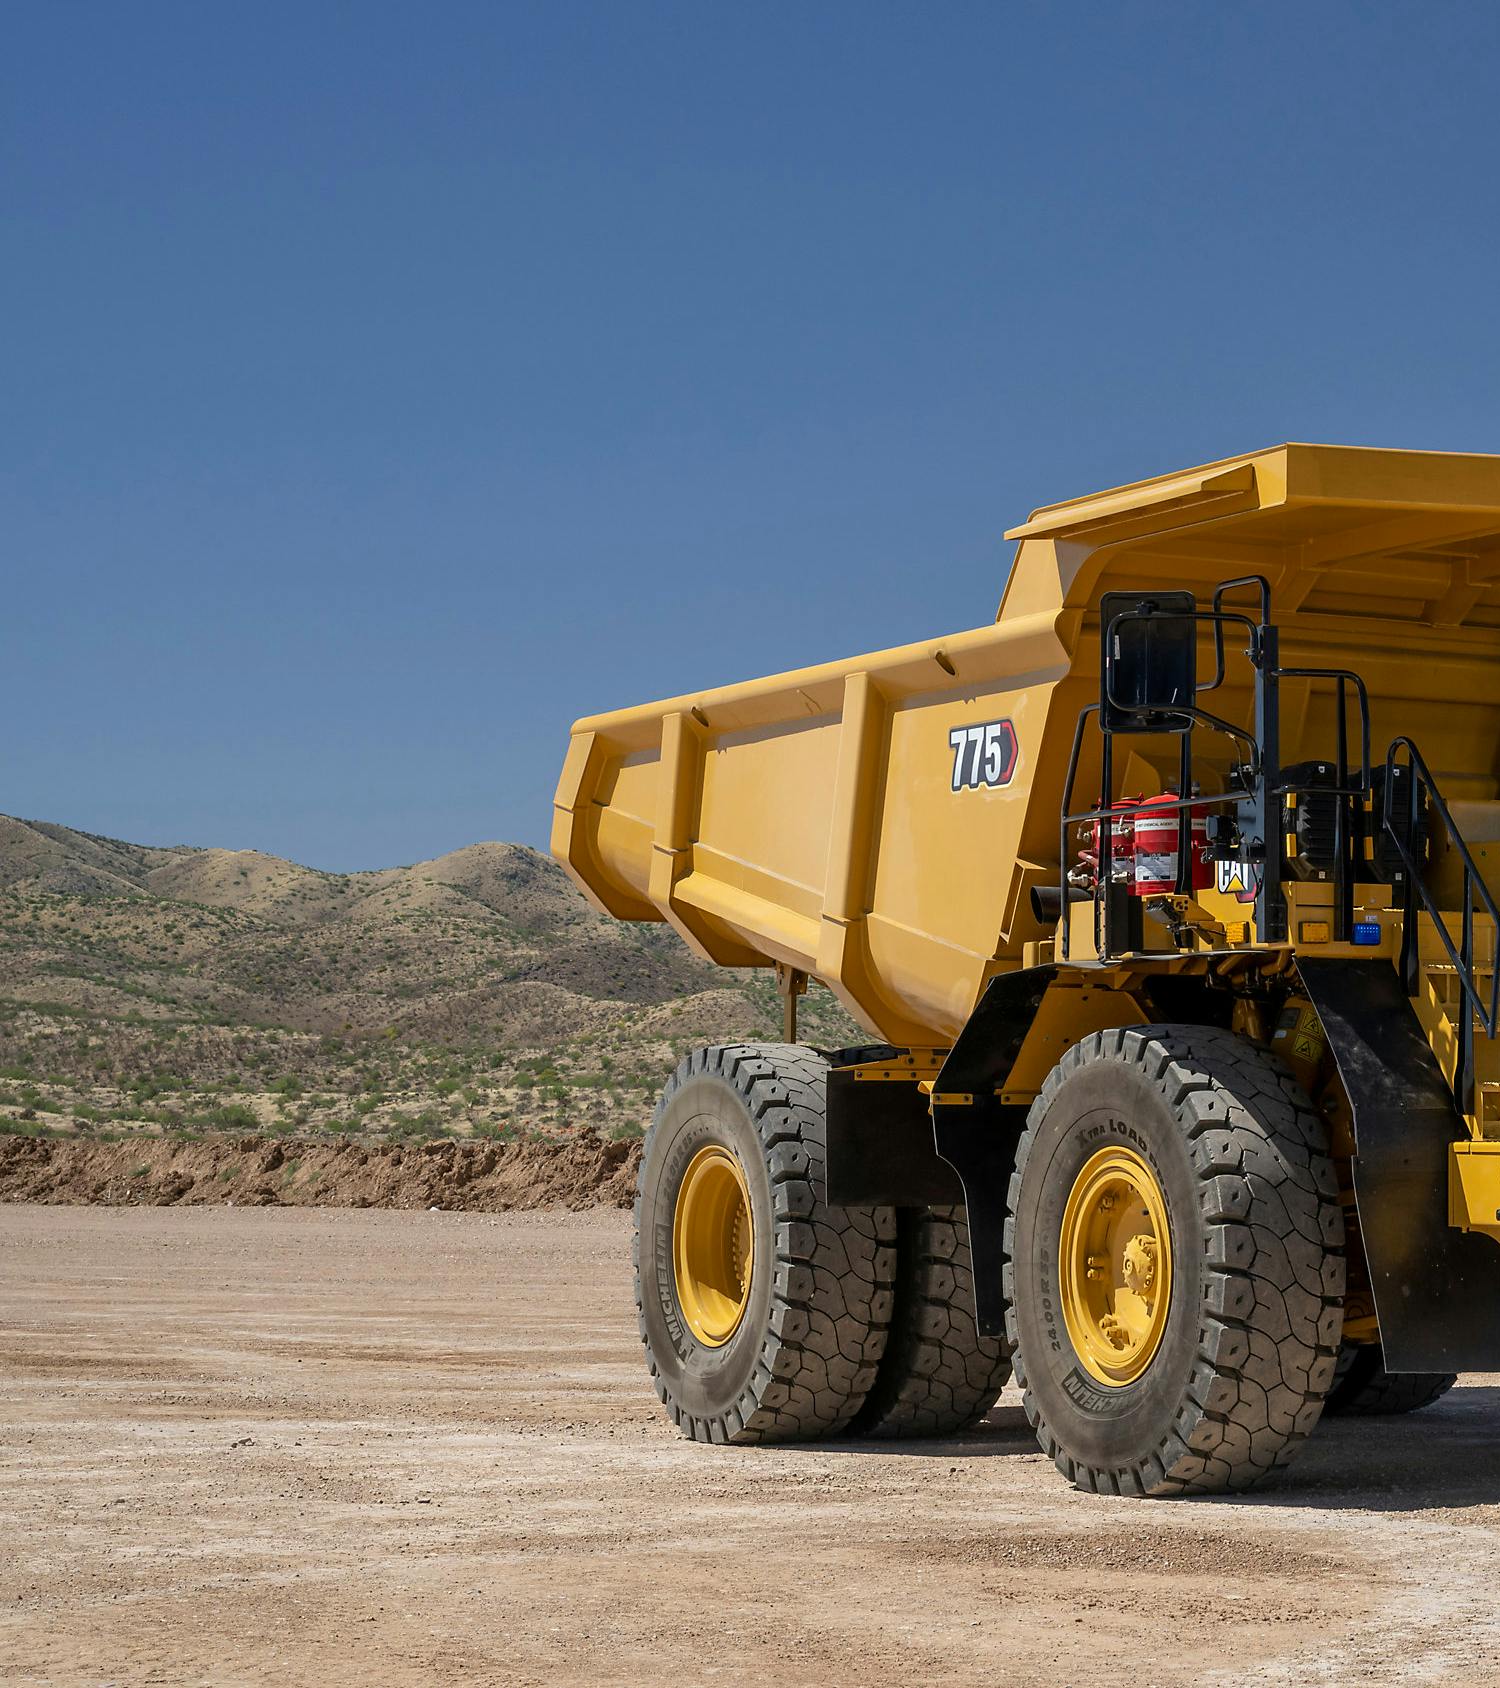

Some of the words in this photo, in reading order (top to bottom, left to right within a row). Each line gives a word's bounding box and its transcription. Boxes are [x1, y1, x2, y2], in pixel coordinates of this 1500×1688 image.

[951, 724, 1001, 787] 775
[1109, 1118, 1148, 1152] LOAD
[655, 1229, 684, 1342] MICHELIN
[1064, 1375, 1134, 1413] CHELIN
